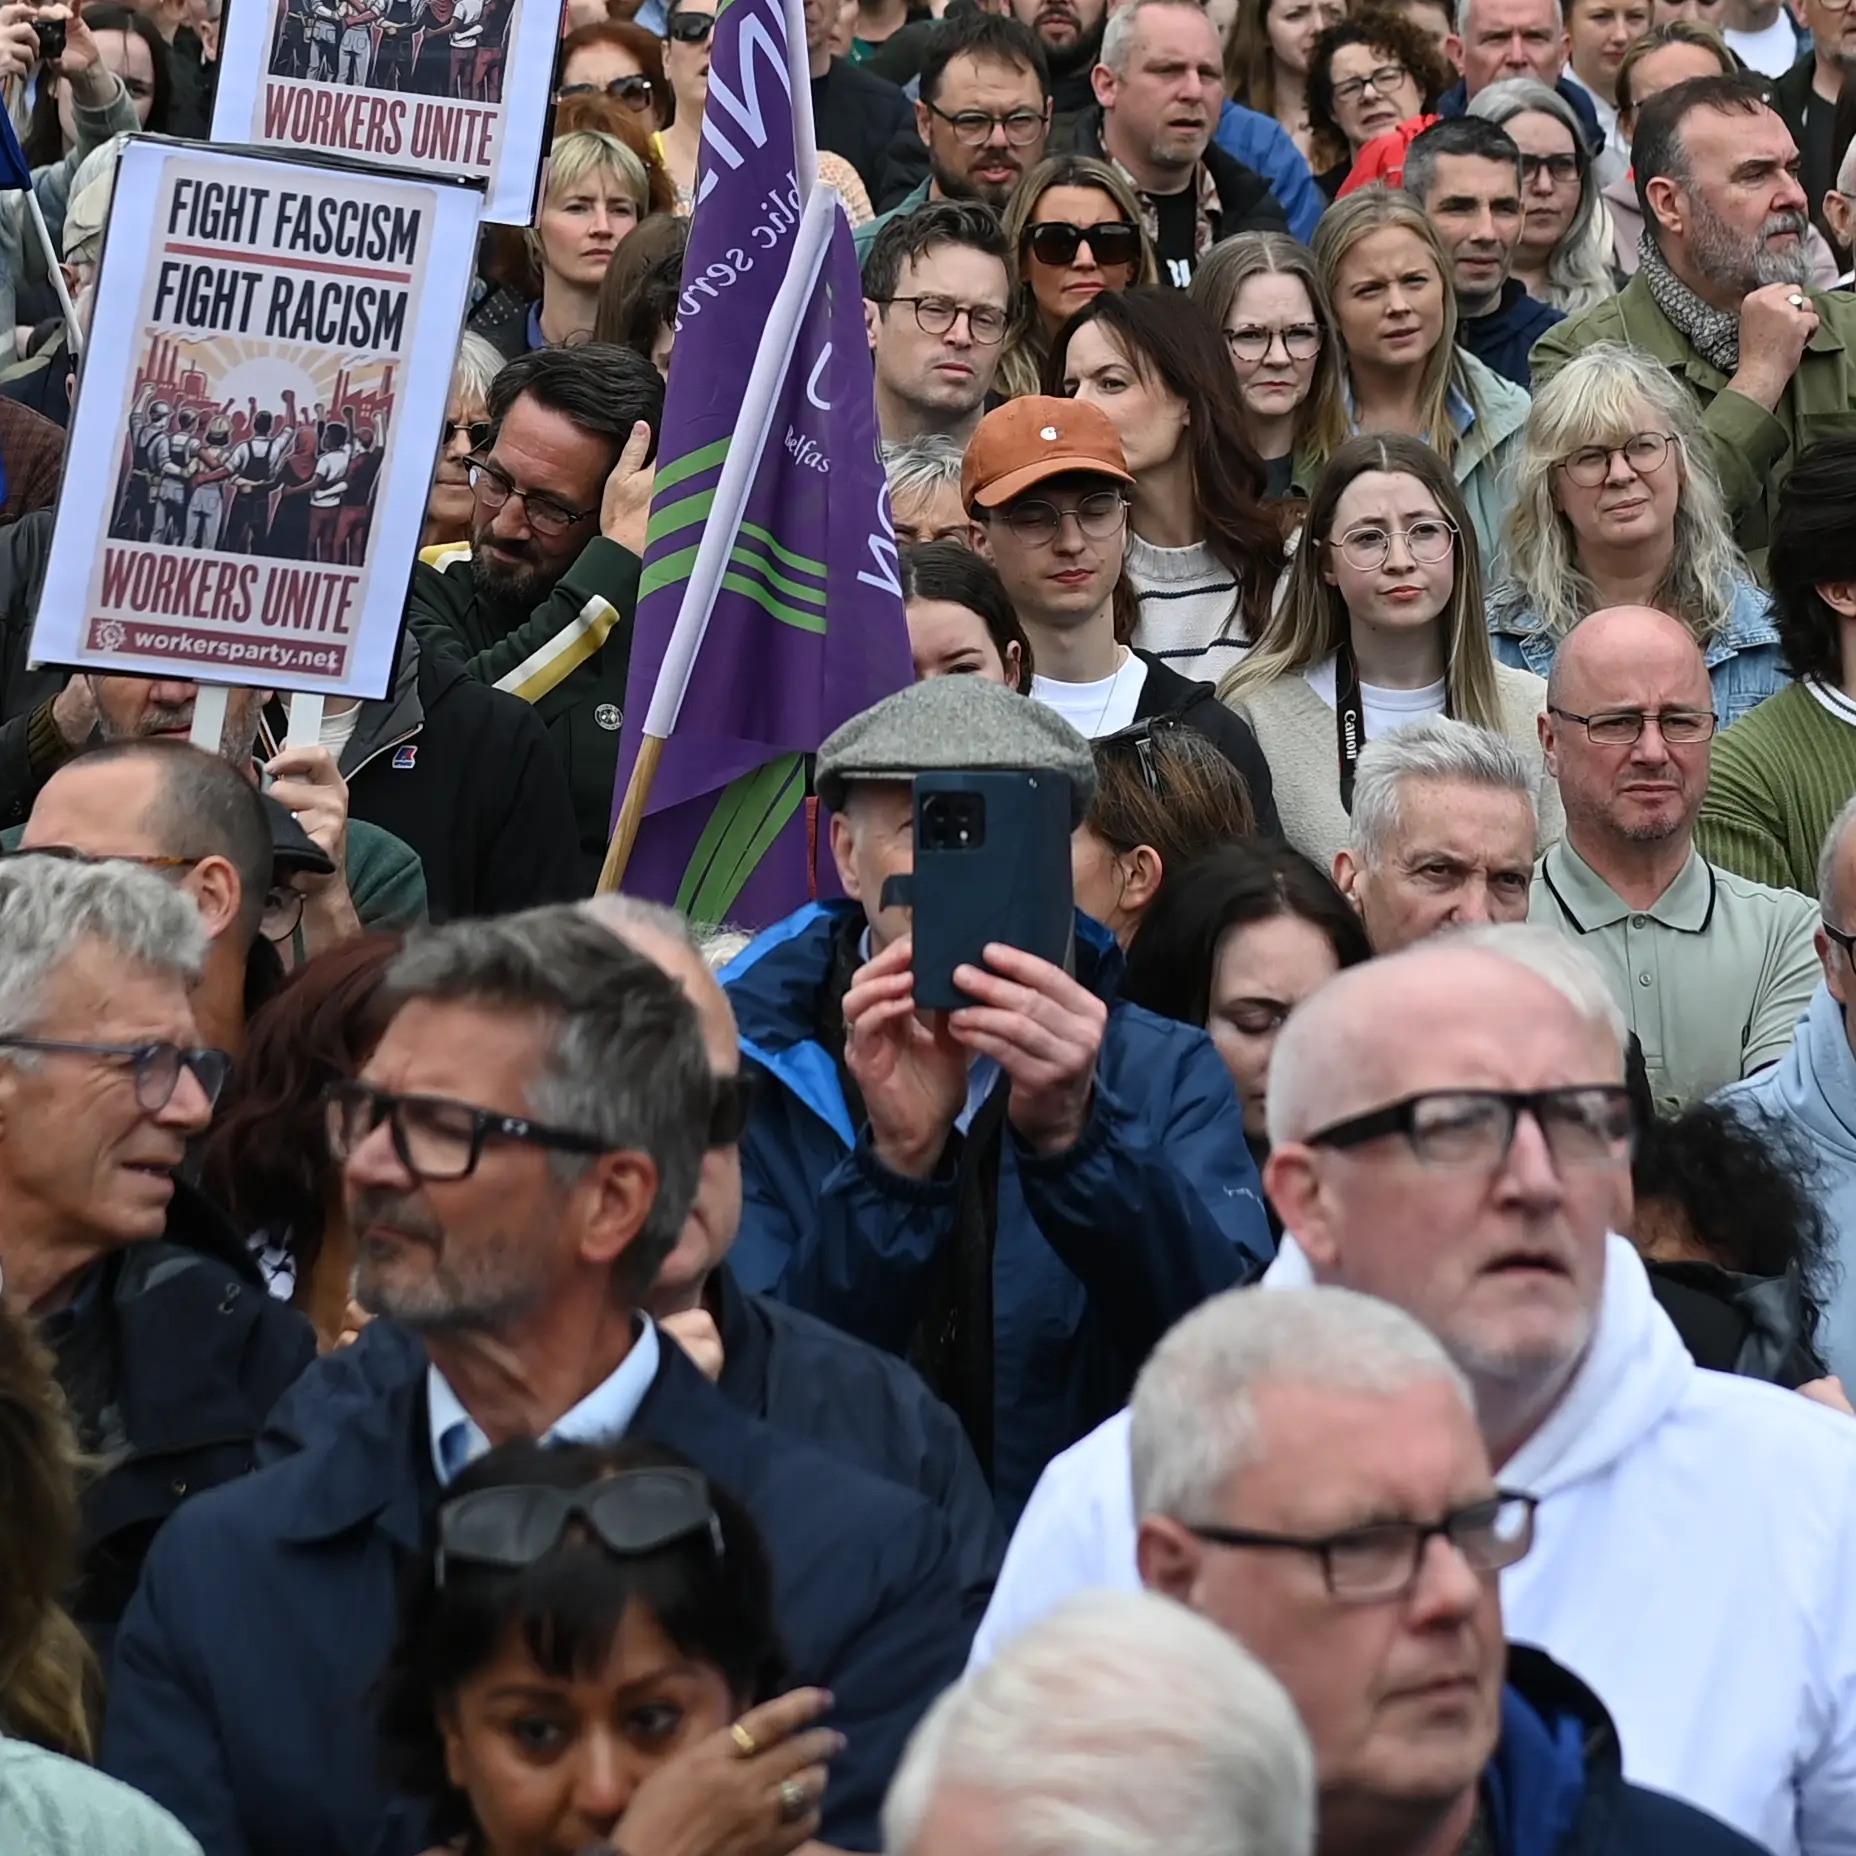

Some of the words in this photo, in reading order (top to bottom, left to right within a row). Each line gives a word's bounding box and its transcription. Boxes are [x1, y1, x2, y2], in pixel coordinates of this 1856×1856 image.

[264, 82, 407, 157] WORKERS
[410, 101, 498, 169] UNITE
[168, 178, 270, 246] FIGHT
[271, 191, 423, 266] FASCISM
[151, 260, 264, 334] FIGHT
[264, 276, 410, 354] RACISM
[785, 424, 832, 474] Belfas
[99, 547, 260, 625] WORKERS
[259, 565, 361, 637] UNITE
[133, 629, 341, 671] workersparty.net
[1344, 709, 1358, 760] Canon
